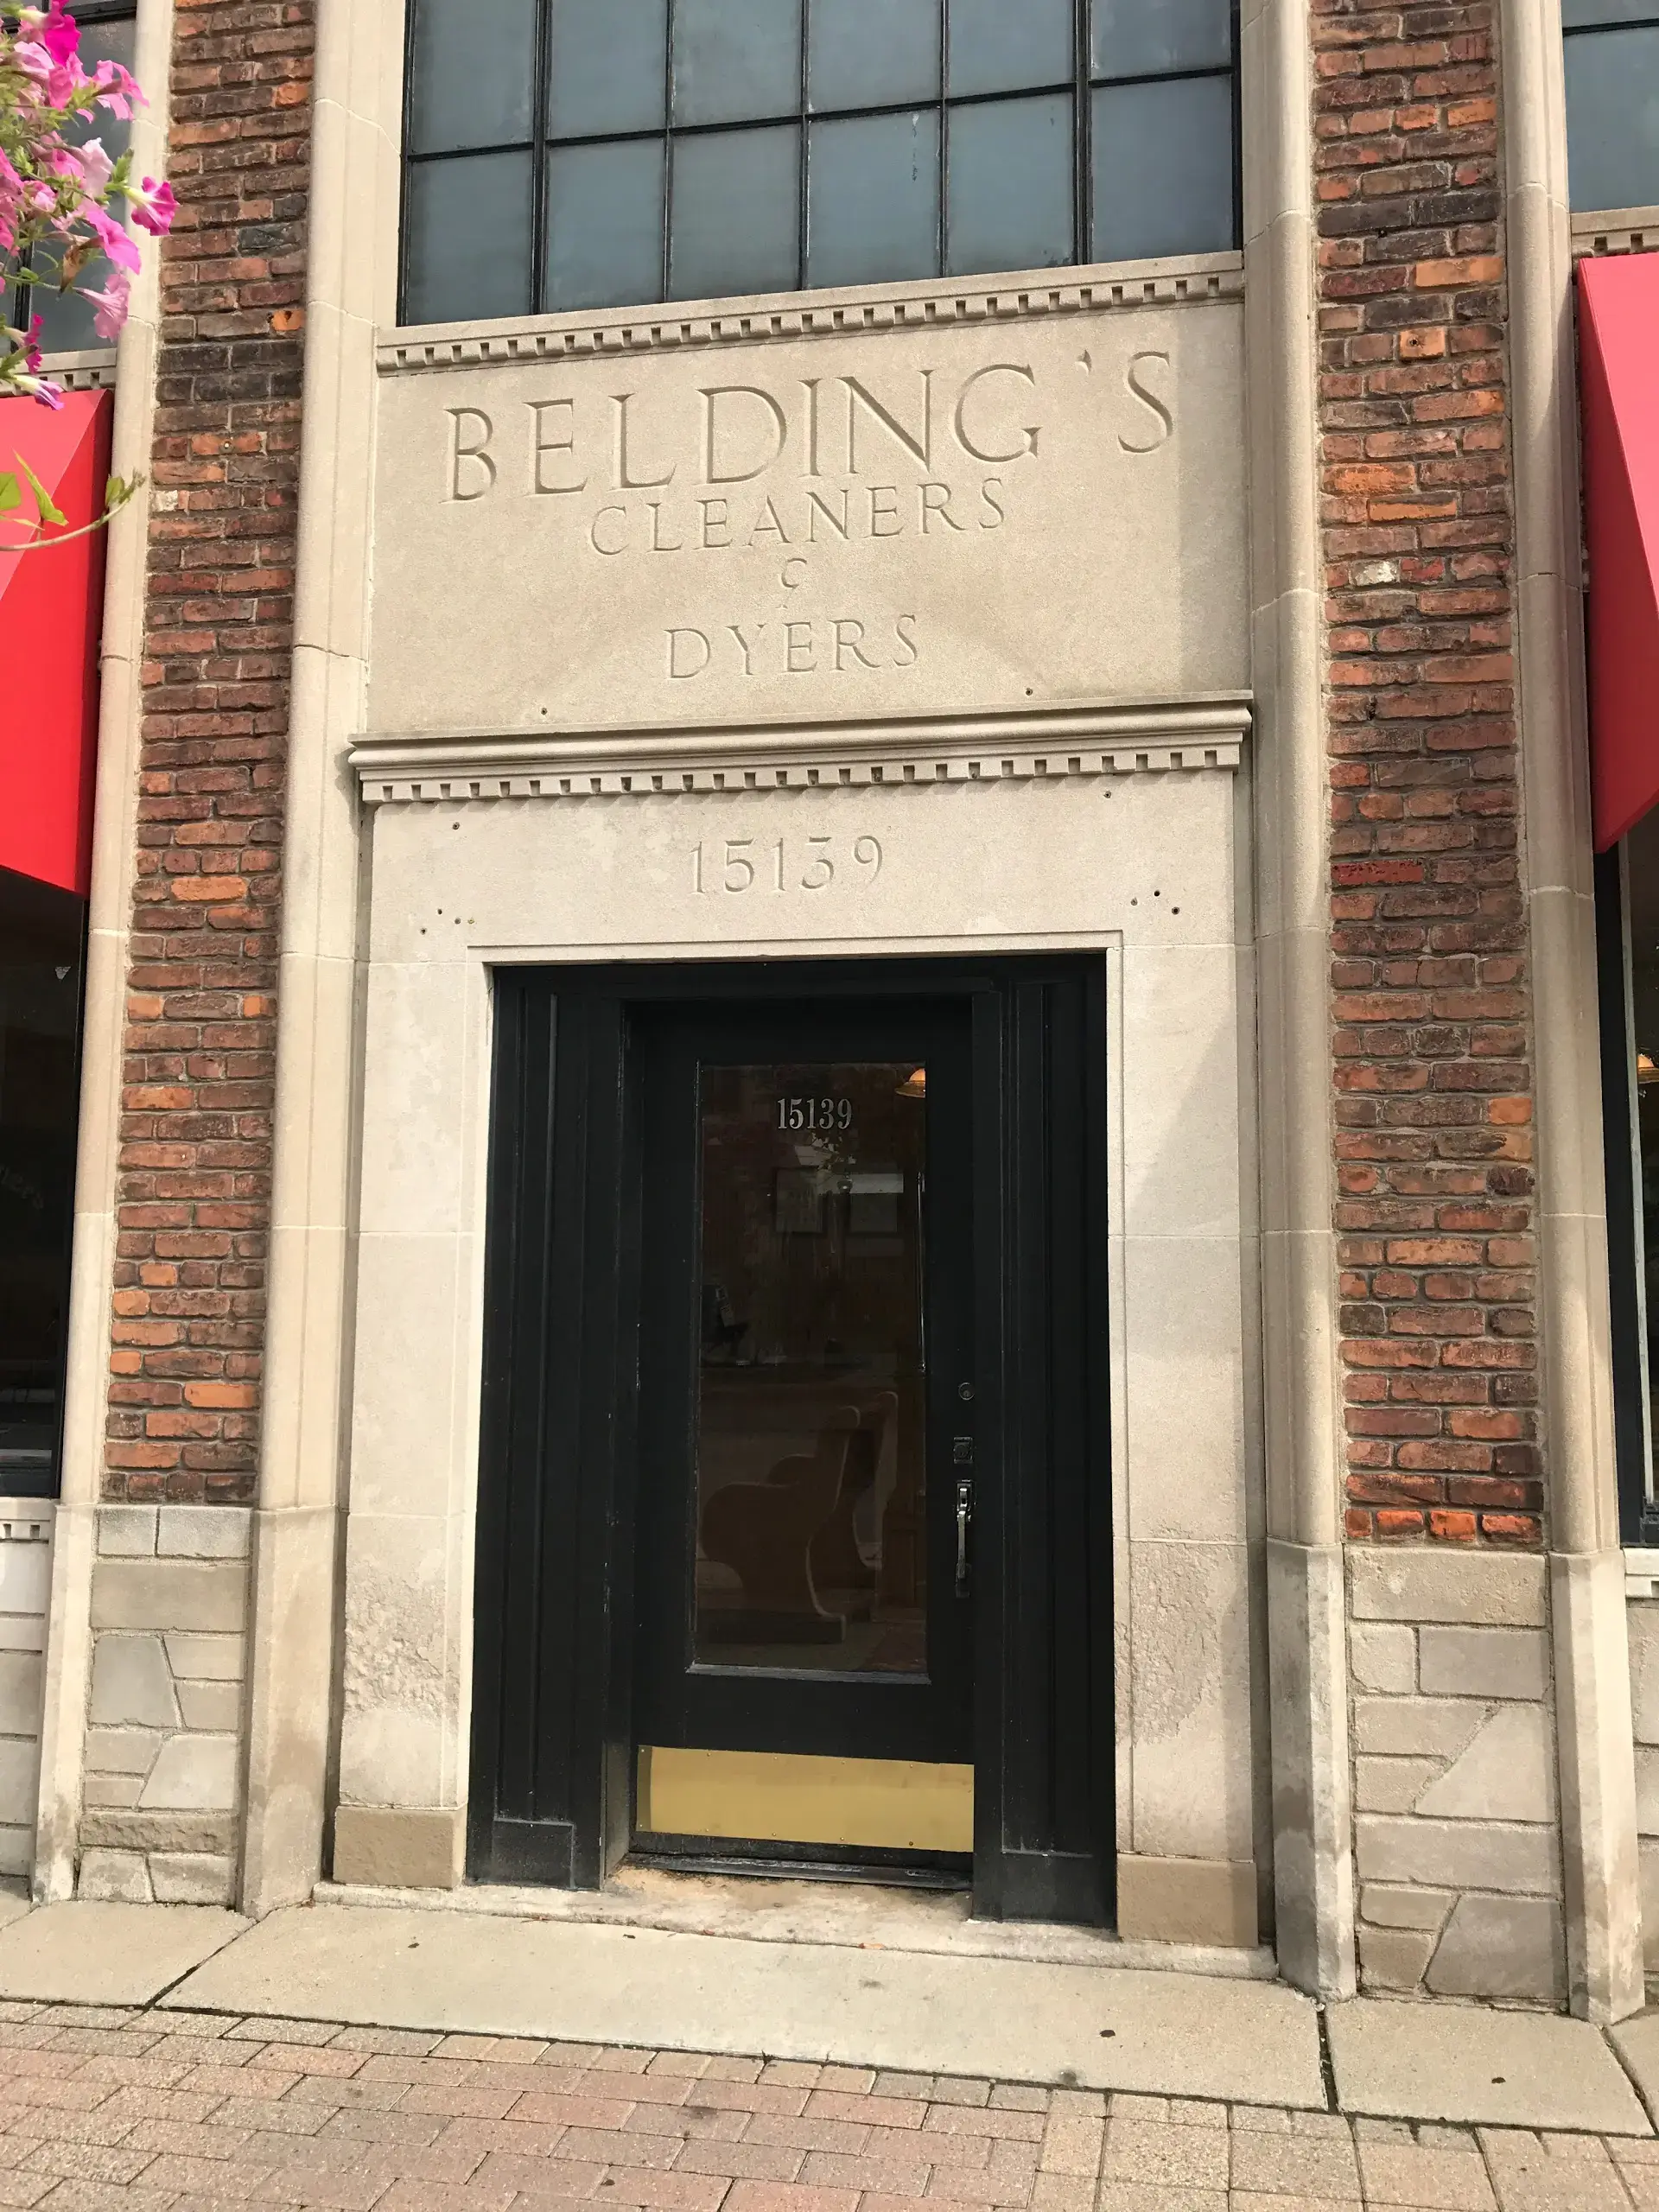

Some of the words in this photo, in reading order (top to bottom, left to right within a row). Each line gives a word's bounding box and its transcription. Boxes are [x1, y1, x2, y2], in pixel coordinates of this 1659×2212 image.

[442, 350, 1175, 503] BELDING'S
[591, 477, 1005, 555] CLEANERS
[664, 613, 918, 679] DYERS
[690, 835, 884, 894] 15139
[777, 1097, 853, 1130] 15139
